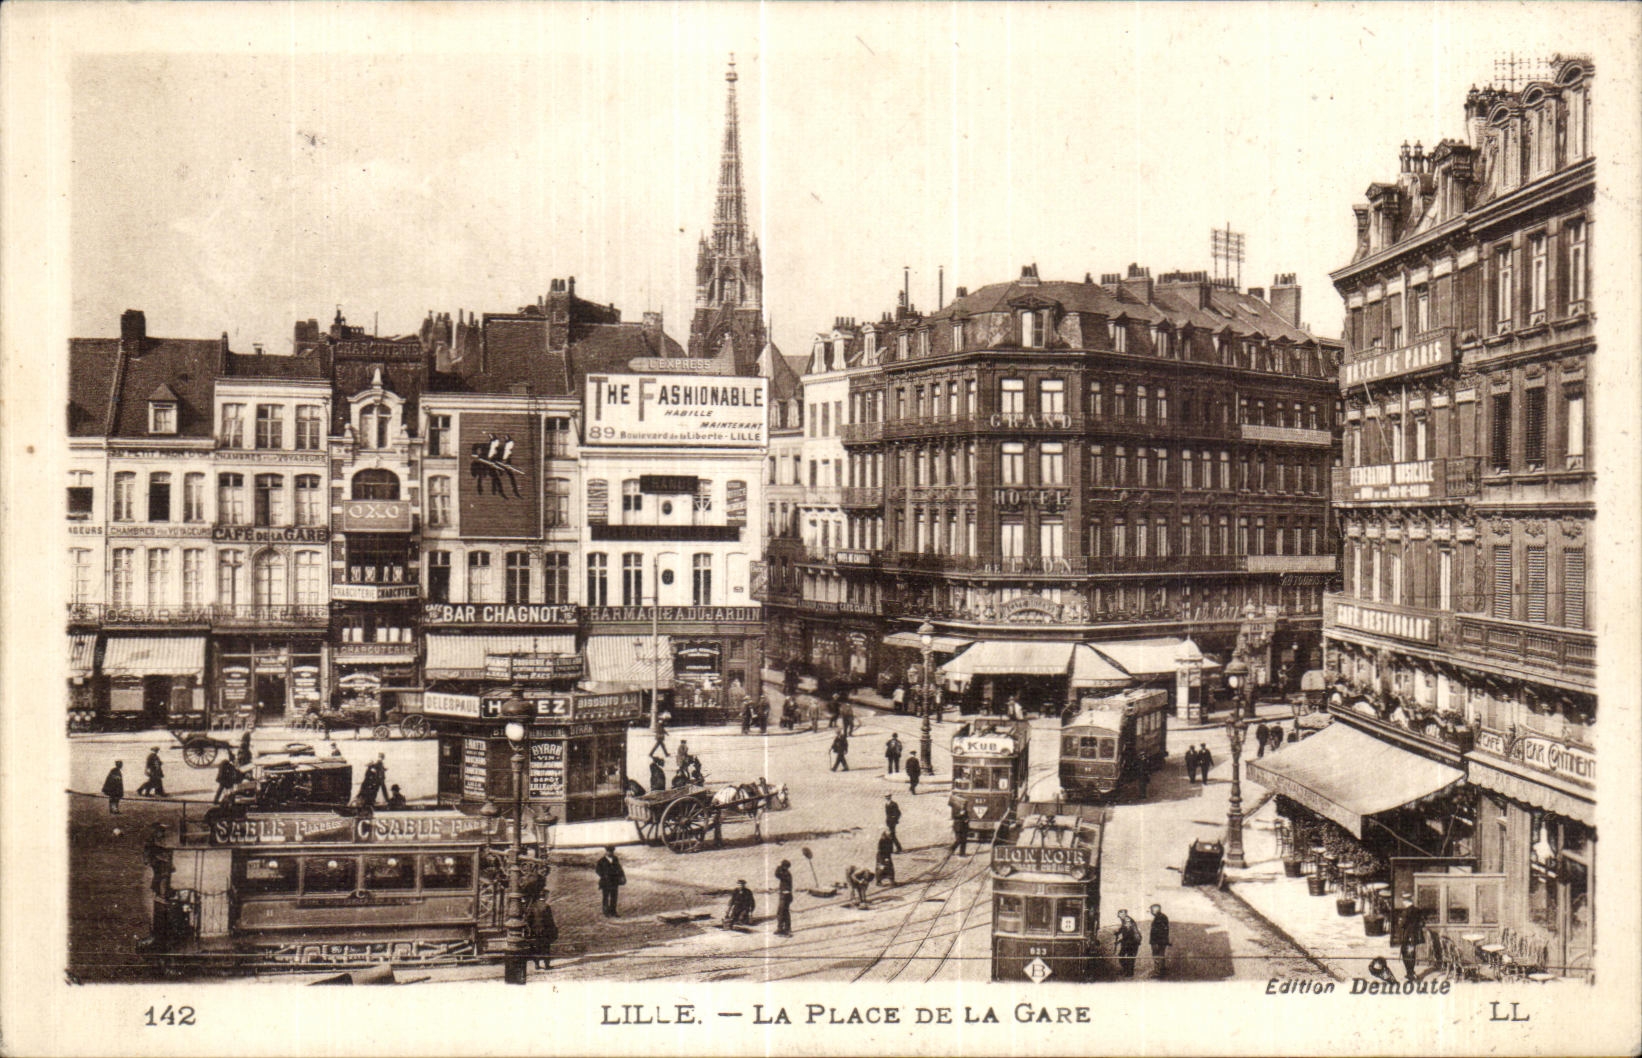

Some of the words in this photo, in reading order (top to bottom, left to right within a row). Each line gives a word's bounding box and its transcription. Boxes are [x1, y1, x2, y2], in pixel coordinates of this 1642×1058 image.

[1405, 341, 1442, 370] PARIS
[648, 359, 712, 369] L'EXPRESS
[589, 376, 631, 421] THE
[638, 377, 764, 422] FASHIONABLE
[664, 410, 714, 418] HABILLE
[990, 413, 1072, 429] GRAND
[700, 422, 763, 430] MAINTENANT
[589, 426, 616, 440] 89
[731, 432, 761, 441] LILLE
[349, 505, 399, 519] OXO
[110, 527, 155, 535] CHAMBRES
[168, 528, 213, 536] VOYAGEURS
[256, 531, 268, 541] DE
[283, 528, 327, 541] GARE
[1011, 558, 1073, 573] LYON
[444, 606, 476, 622] BAR
[483, 606, 560, 622] CHAGNOT
[341, 645, 409, 655] CHARCUTERIE
[488, 700, 565, 714] HEZ
[967, 742, 997, 751] KUB
[357, 820, 370, 838] C
[994, 848, 1036, 863] LION
[1041, 849, 1086, 865] NOIR
[1032, 964, 1045, 977] B
